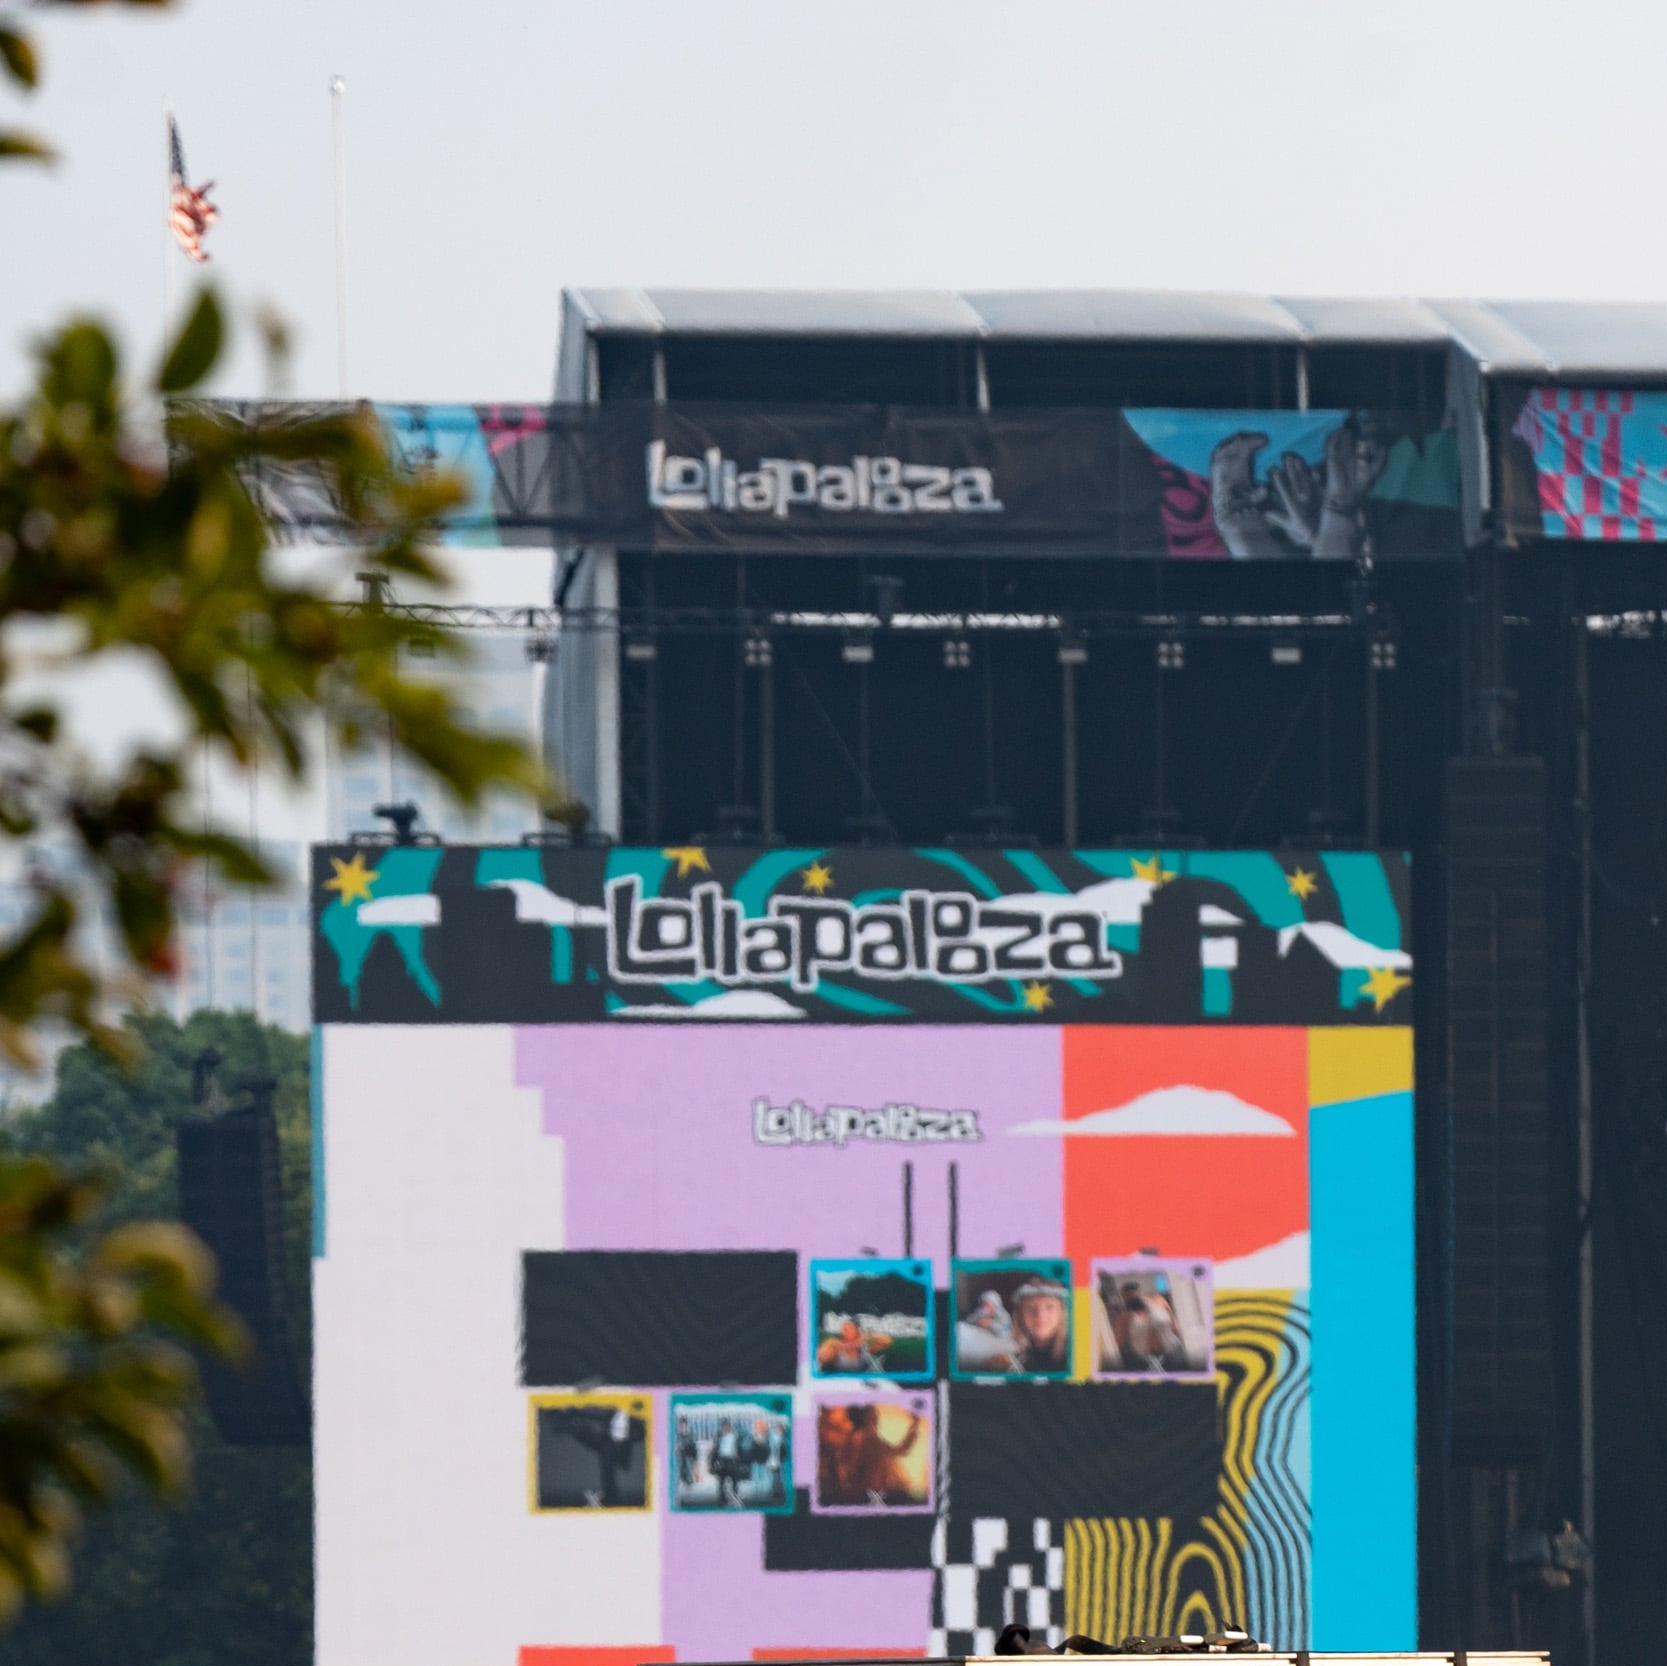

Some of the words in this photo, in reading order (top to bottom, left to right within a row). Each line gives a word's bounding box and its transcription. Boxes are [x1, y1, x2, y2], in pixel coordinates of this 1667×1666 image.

[647, 439, 1004, 519] Lollapalooza
[604, 874, 1122, 992] Lollapalooza
[754, 1096, 984, 1149] Lollapalooza
